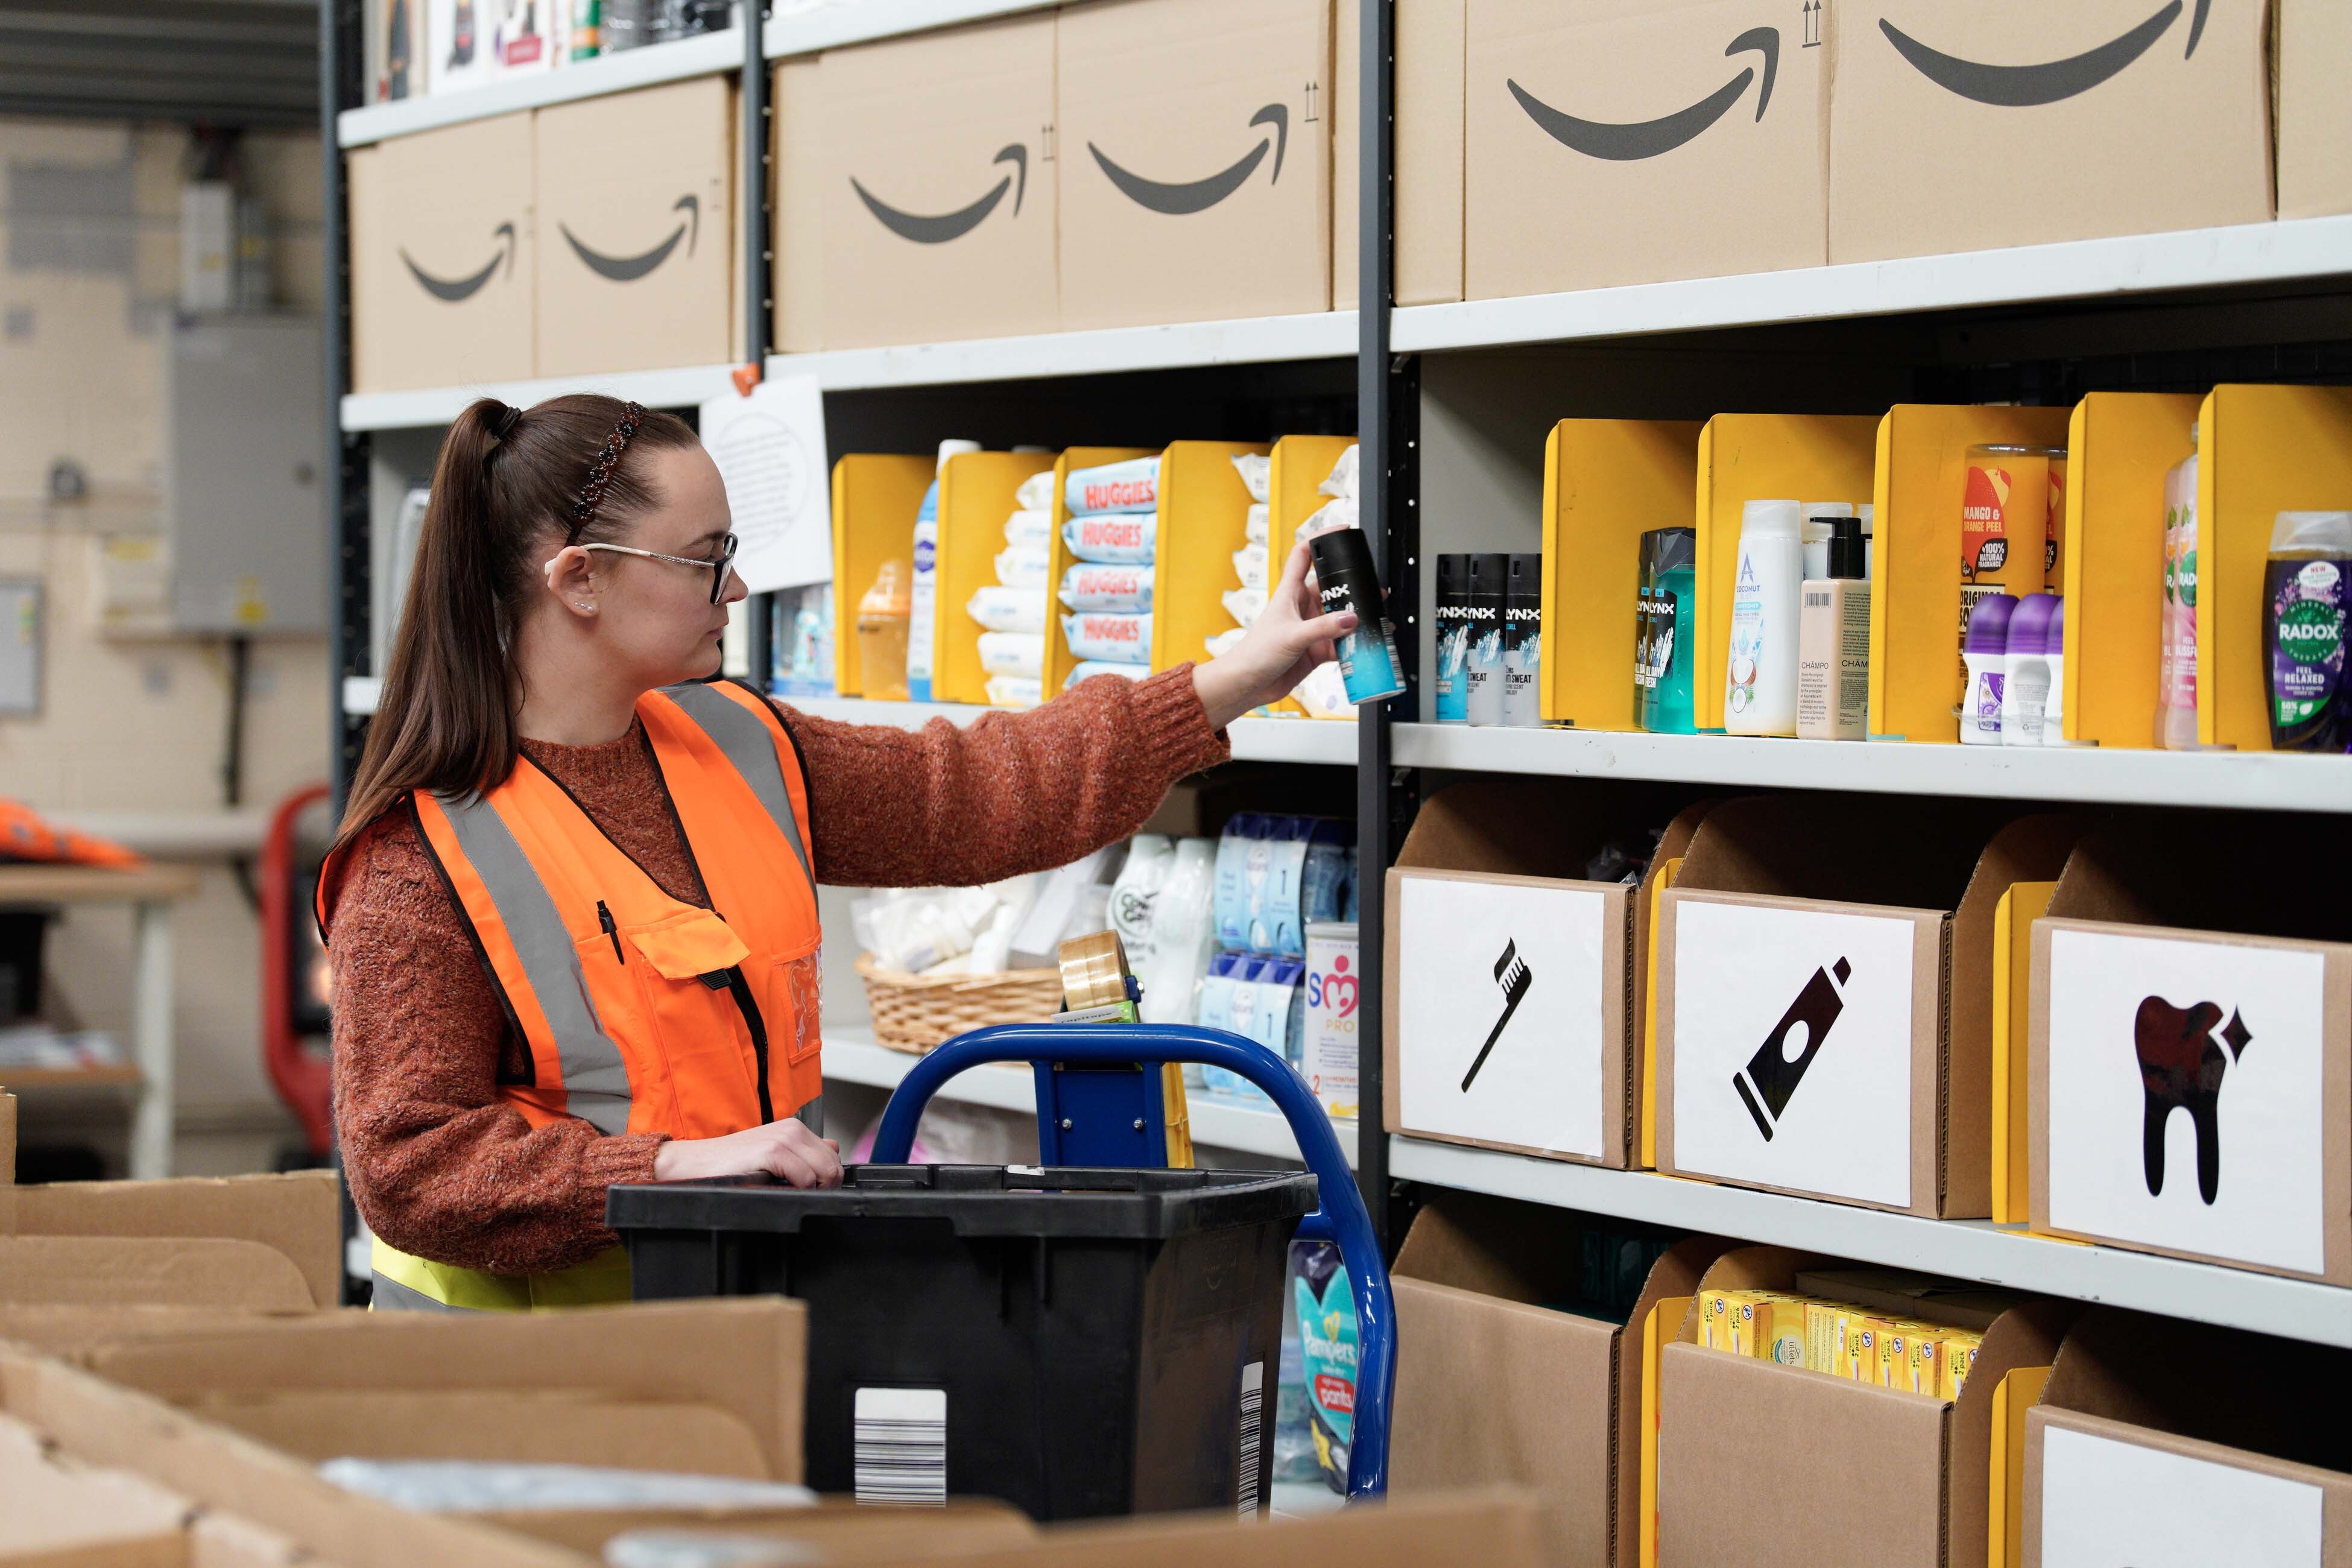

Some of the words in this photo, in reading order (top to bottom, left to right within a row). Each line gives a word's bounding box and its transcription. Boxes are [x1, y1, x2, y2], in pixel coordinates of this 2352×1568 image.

[1086, 480, 1154, 510] HUGGIES
[1964, 507, 1990, 520] MANGO
[1993, 509, 2000, 520] &
[1964, 521, 1984, 532] ORANGE
[1986, 521, 2002, 532] PEEL
[1082, 522, 1141, 547] HUGGIES
[1985, 543, 2005, 554] 100%
[1078, 571, 1138, 594] HUGGIES
[1320, 583, 1350, 603] YNX
[1437, 607, 1467, 618] YNX
[1467, 607, 1495, 619] YNX
[1637, 601, 1649, 612] LYN
[1649, 602, 1674, 615] LYNX
[1083, 617, 1139, 641] HUGGIES
[2280, 624, 2338, 640] RADOX
[1470, 672, 1487, 681] SWEAT
[1511, 674, 1532, 683] SWEAT
[2284, 673, 2324, 684] RELAXED
[1326, 1019, 1355, 1032] PRO
[1313, 1074, 1321, 1095] 2
[1302, 1320, 1356, 1367] Pampers
[1320, 1388, 1352, 1408] pants
